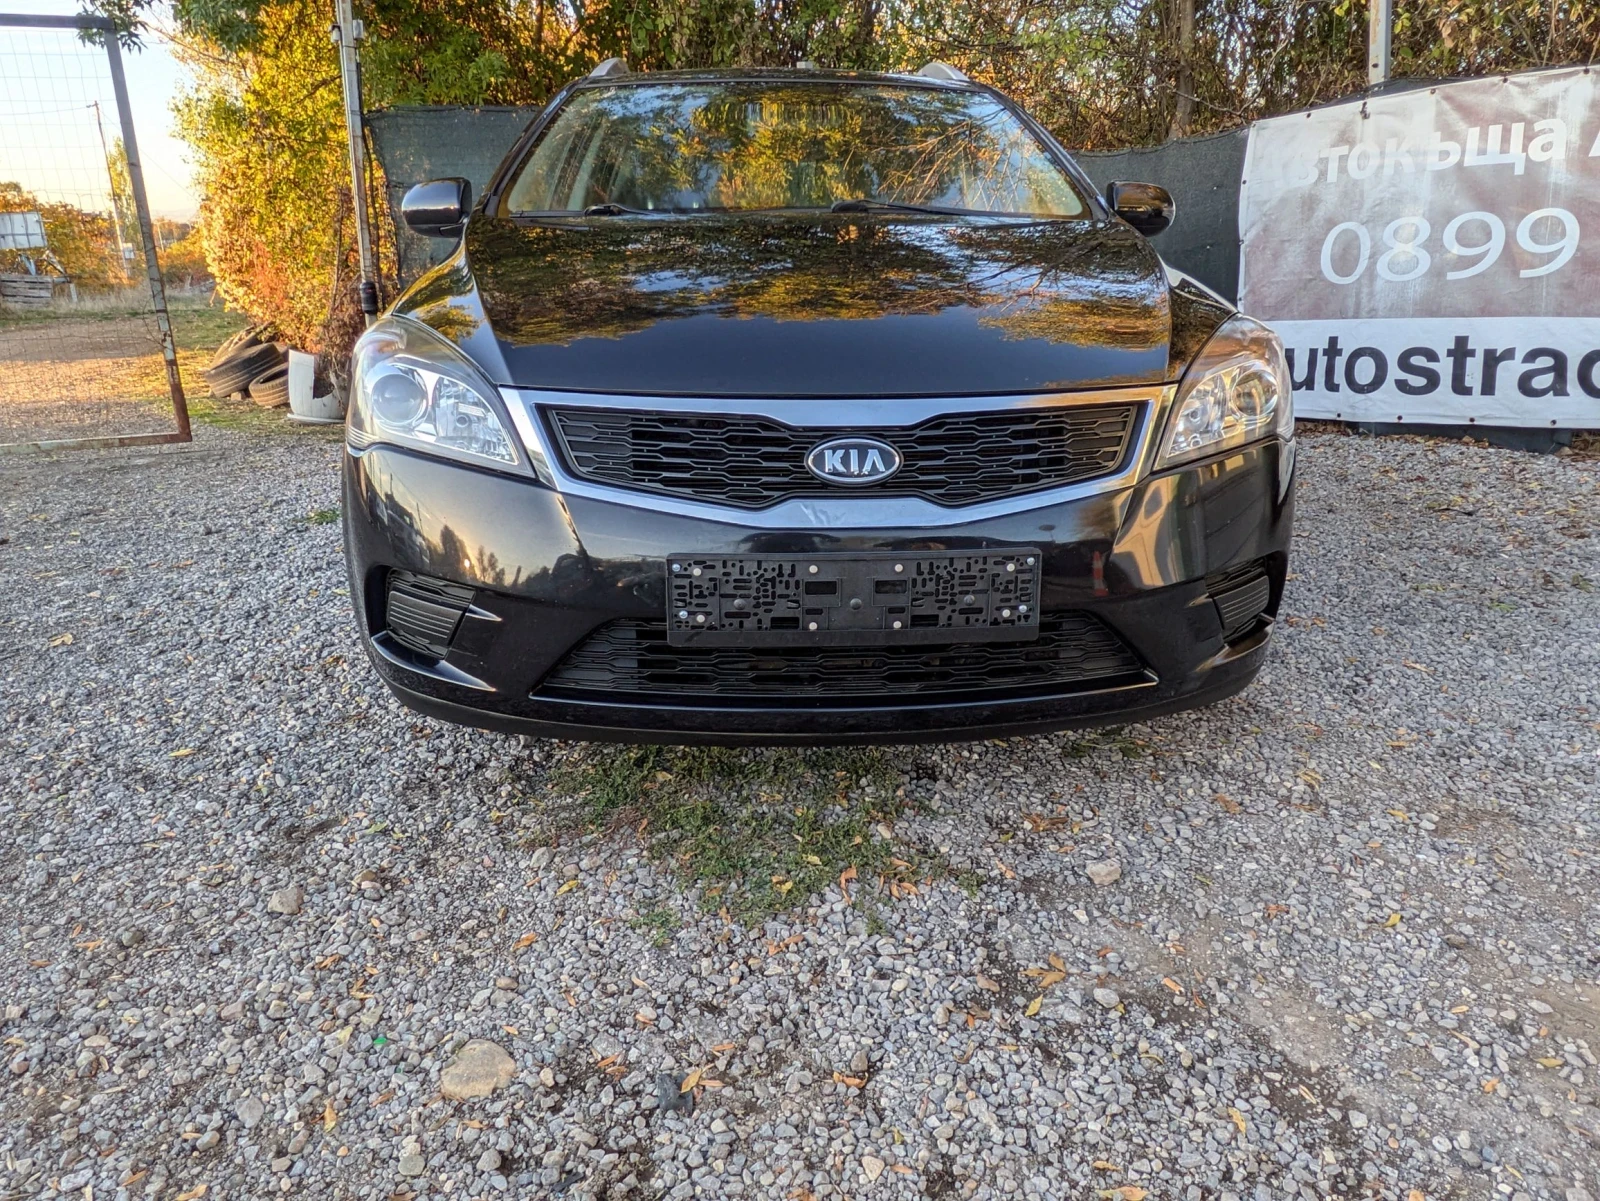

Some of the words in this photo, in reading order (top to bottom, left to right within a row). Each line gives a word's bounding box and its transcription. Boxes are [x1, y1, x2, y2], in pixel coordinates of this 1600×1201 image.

[1263, 118, 1567, 188] втокъща
[1320, 207, 1581, 285] 0899
[1284, 335, 1600, 399] utostra
[823, 448, 886, 474] KIA
